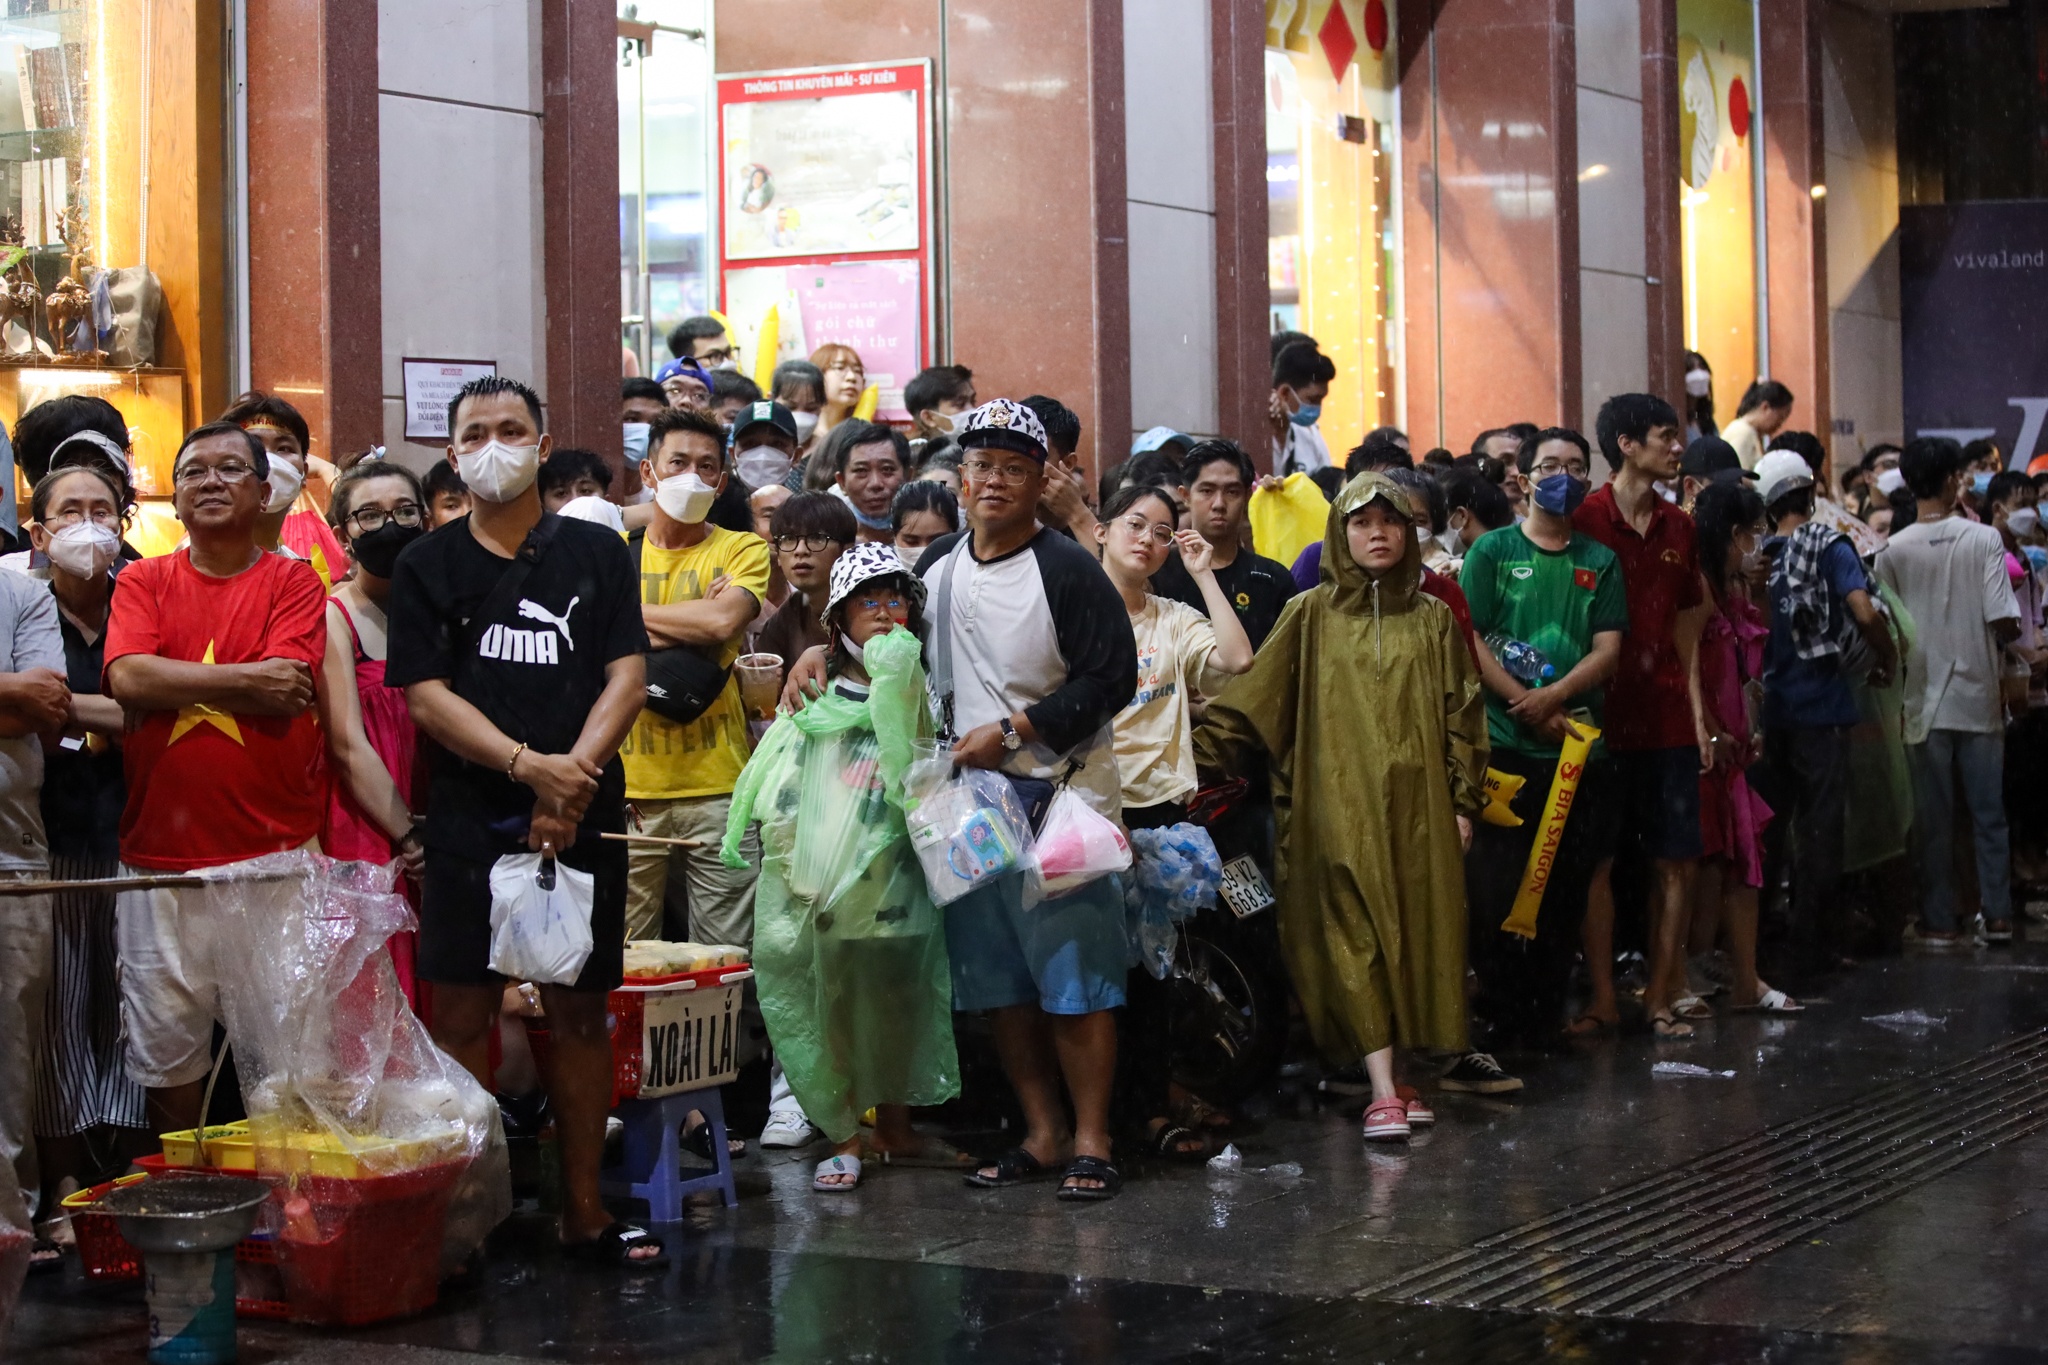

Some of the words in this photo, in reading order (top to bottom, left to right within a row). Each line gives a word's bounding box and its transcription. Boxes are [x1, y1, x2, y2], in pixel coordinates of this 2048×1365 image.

[778, 77, 794, 91] TIN
[1953, 250, 2044, 269] vivaland
[478, 623, 559, 664] UMA
[1551, 788, 1573, 823] BIA
[1529, 825, 1562, 895] SAIGON
[647, 1007, 702, 1087] XOÀI
